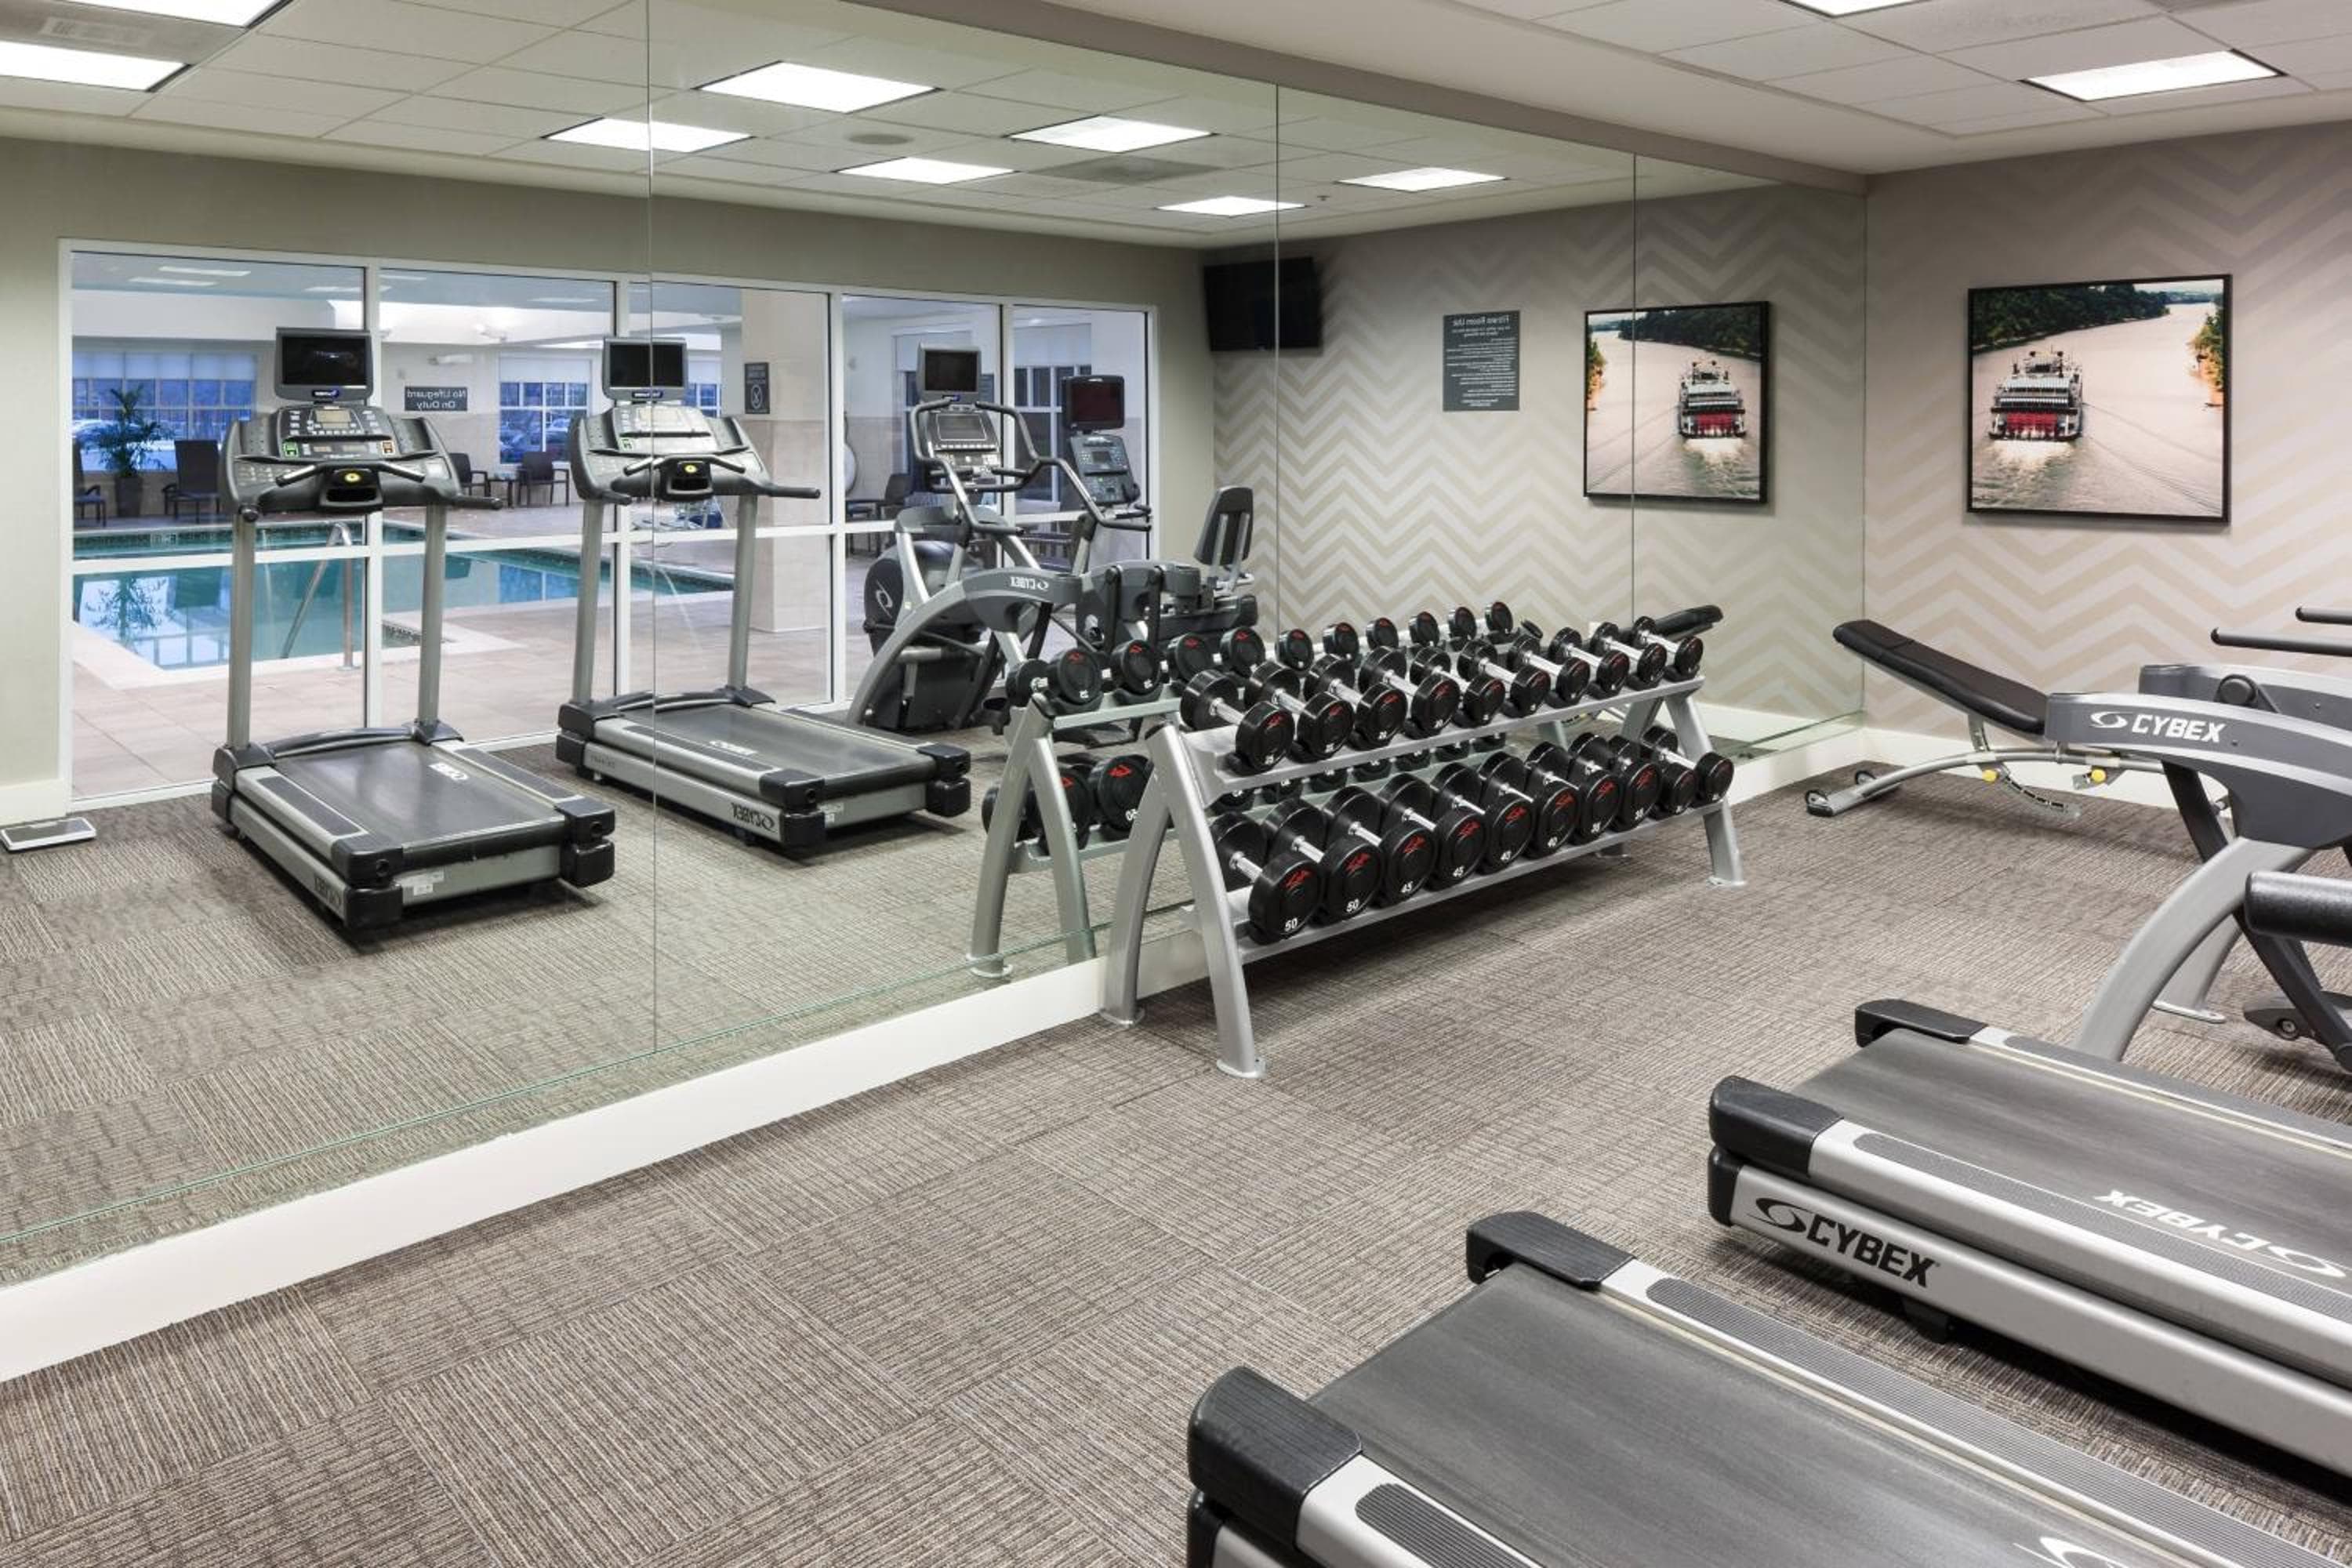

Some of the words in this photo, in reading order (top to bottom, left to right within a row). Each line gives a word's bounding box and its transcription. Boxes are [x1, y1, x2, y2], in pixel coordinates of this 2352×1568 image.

[2132, 713, 2227, 742] CYBEX
[1453, 866, 1465, 877] 45
[1346, 898, 1359, 913] 50
[1284, 918, 1298, 931] 50
[2094, 1190, 2271, 1250] CYBEX
[1806, 1214, 1935, 1288] CYBEX
